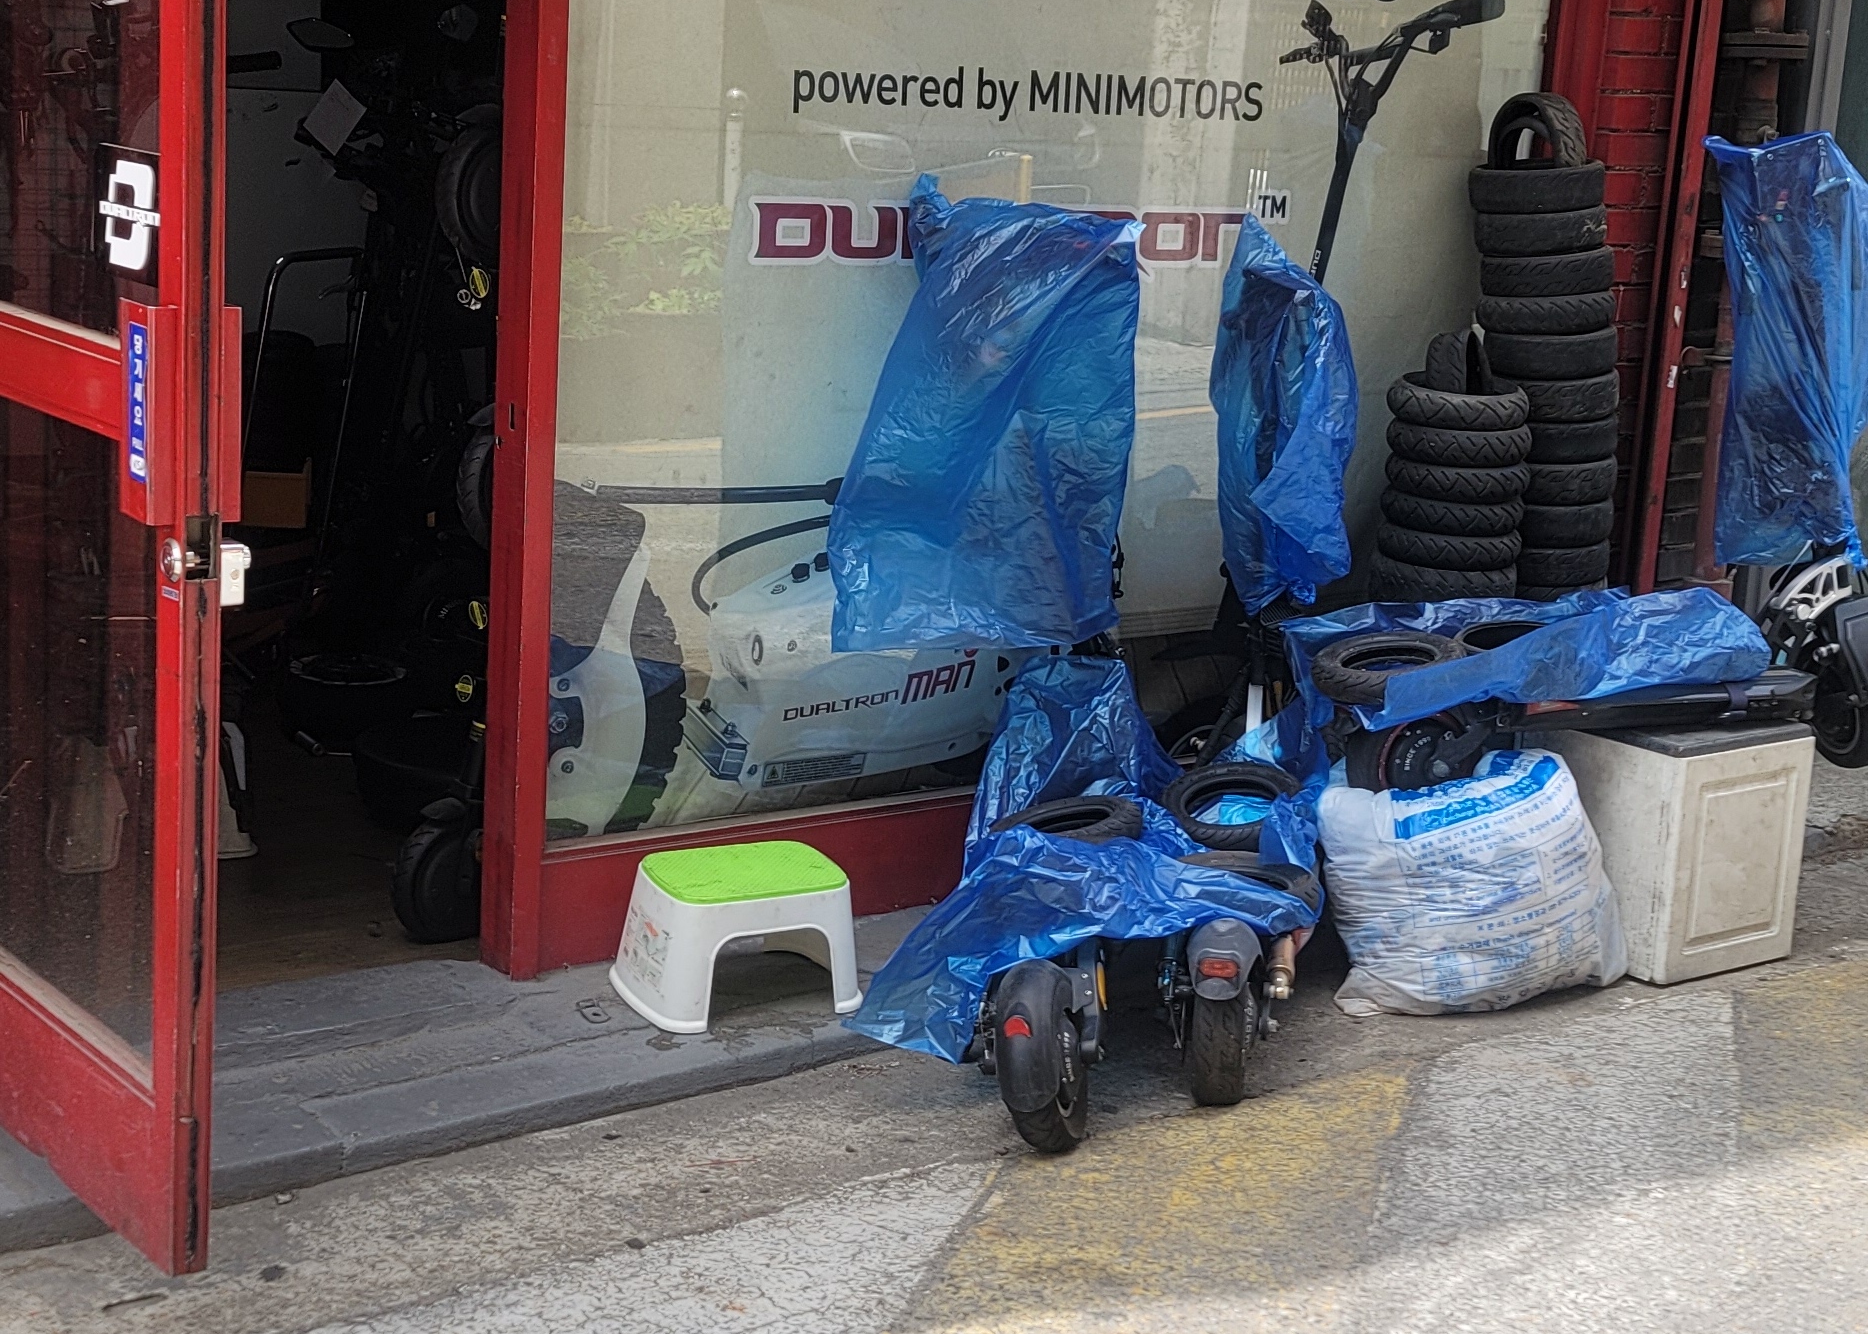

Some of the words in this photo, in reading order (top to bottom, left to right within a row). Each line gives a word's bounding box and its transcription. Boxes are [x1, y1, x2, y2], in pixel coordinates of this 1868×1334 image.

[793, 66, 964, 114] powered
[977, 67, 1019, 122] by
[1029, 70, 1263, 121] MINIMOTORS
[783, 689, 900, 722] DUALTRON
[900, 658, 977, 706] MAN
